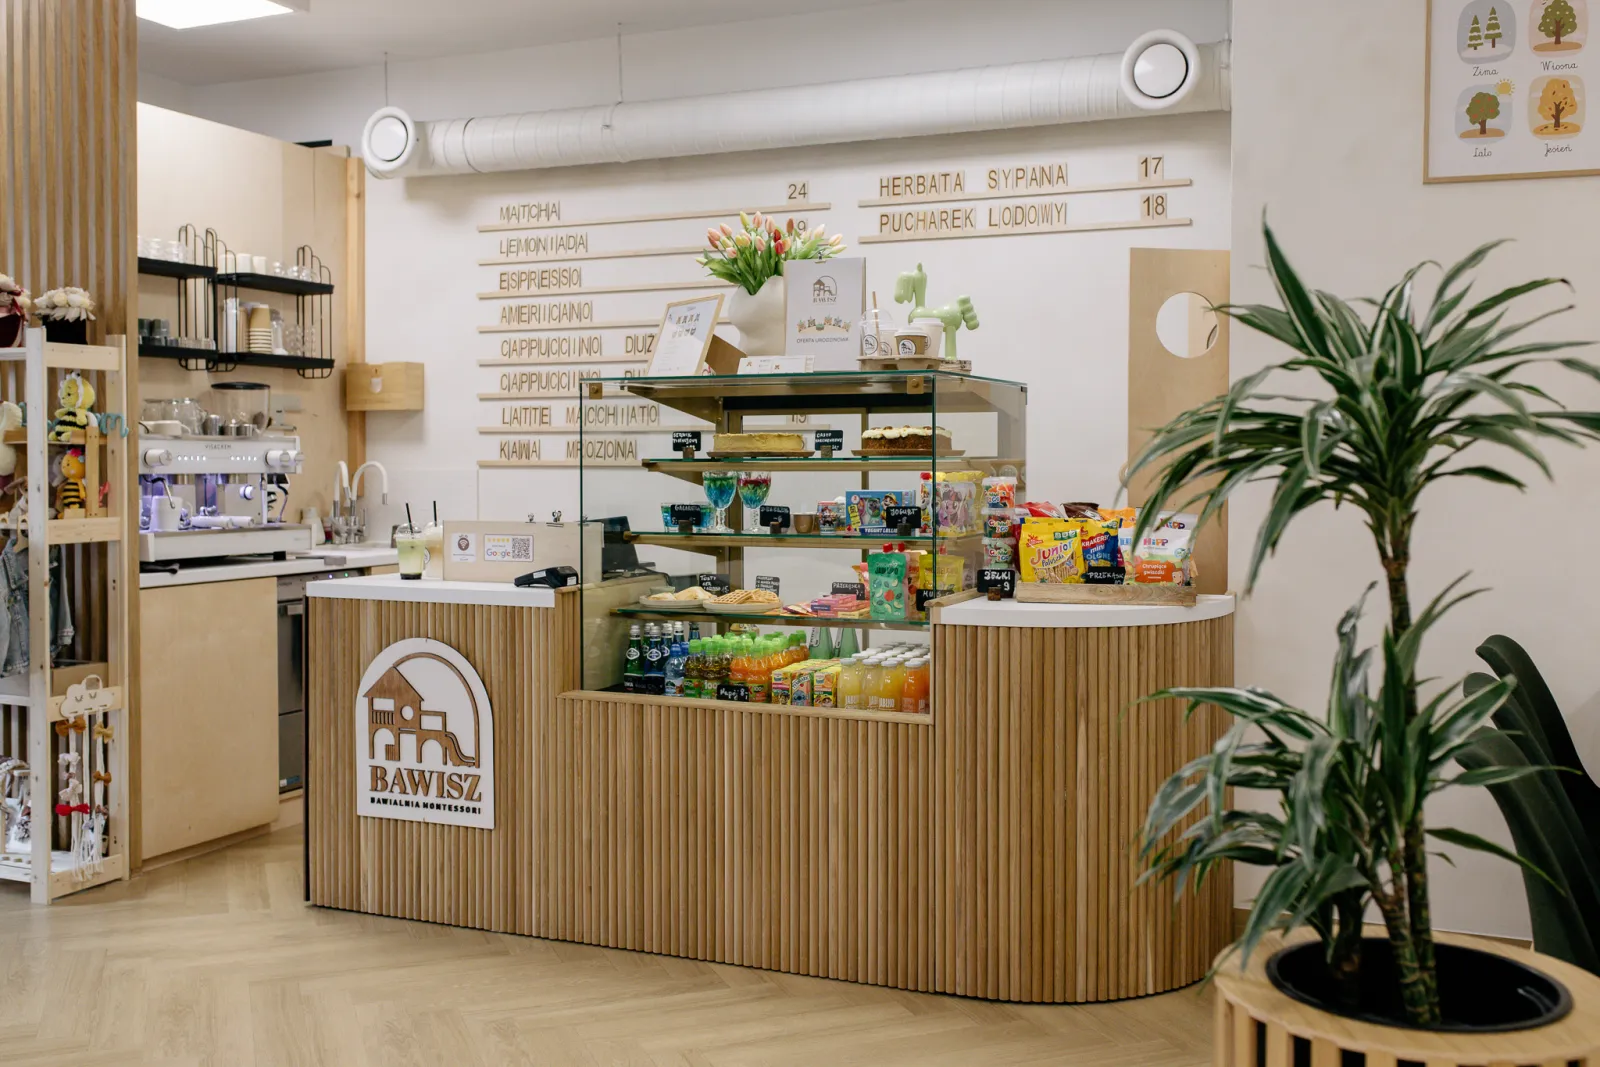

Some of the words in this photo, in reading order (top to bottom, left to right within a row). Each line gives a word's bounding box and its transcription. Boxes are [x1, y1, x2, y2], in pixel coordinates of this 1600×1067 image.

[1472, 66, 1499, 77] Zima
[1540, 60, 1578, 71] Wiosna
[1472, 148, 1493, 158] Lato
[880, 172, 963, 197] HERBATA
[988, 163, 1066, 189] SYPANA
[1140, 157, 1163, 178] 17
[499, 202, 558, 221] MATCHA
[788, 183, 808, 200] 24
[880, 207, 974, 233] PUCHAREK
[988, 203, 1064, 227] LODOWY
[1143, 195, 1166, 217] 18
[499, 235, 587, 256] LEMONIADA
[499, 268, 580, 291] ESPRESSO
[500, 302, 592, 324] AMERICANO
[500, 336, 600, 358] CAPPUCCINO
[501, 406, 549, 425] LATTE
[565, 405, 658, 425] MACCHIATO
[500, 440, 539, 460] KAWA
[1030, 538, 1074, 566] Junior
[1143, 537, 1169, 547] HiPP
[486, 548, 511, 559] Google
[368, 764, 482, 803] BAWISZ
[370, 796, 420, 809] BAWIALNIA
[423, 801, 481, 815] MONTESSORI
